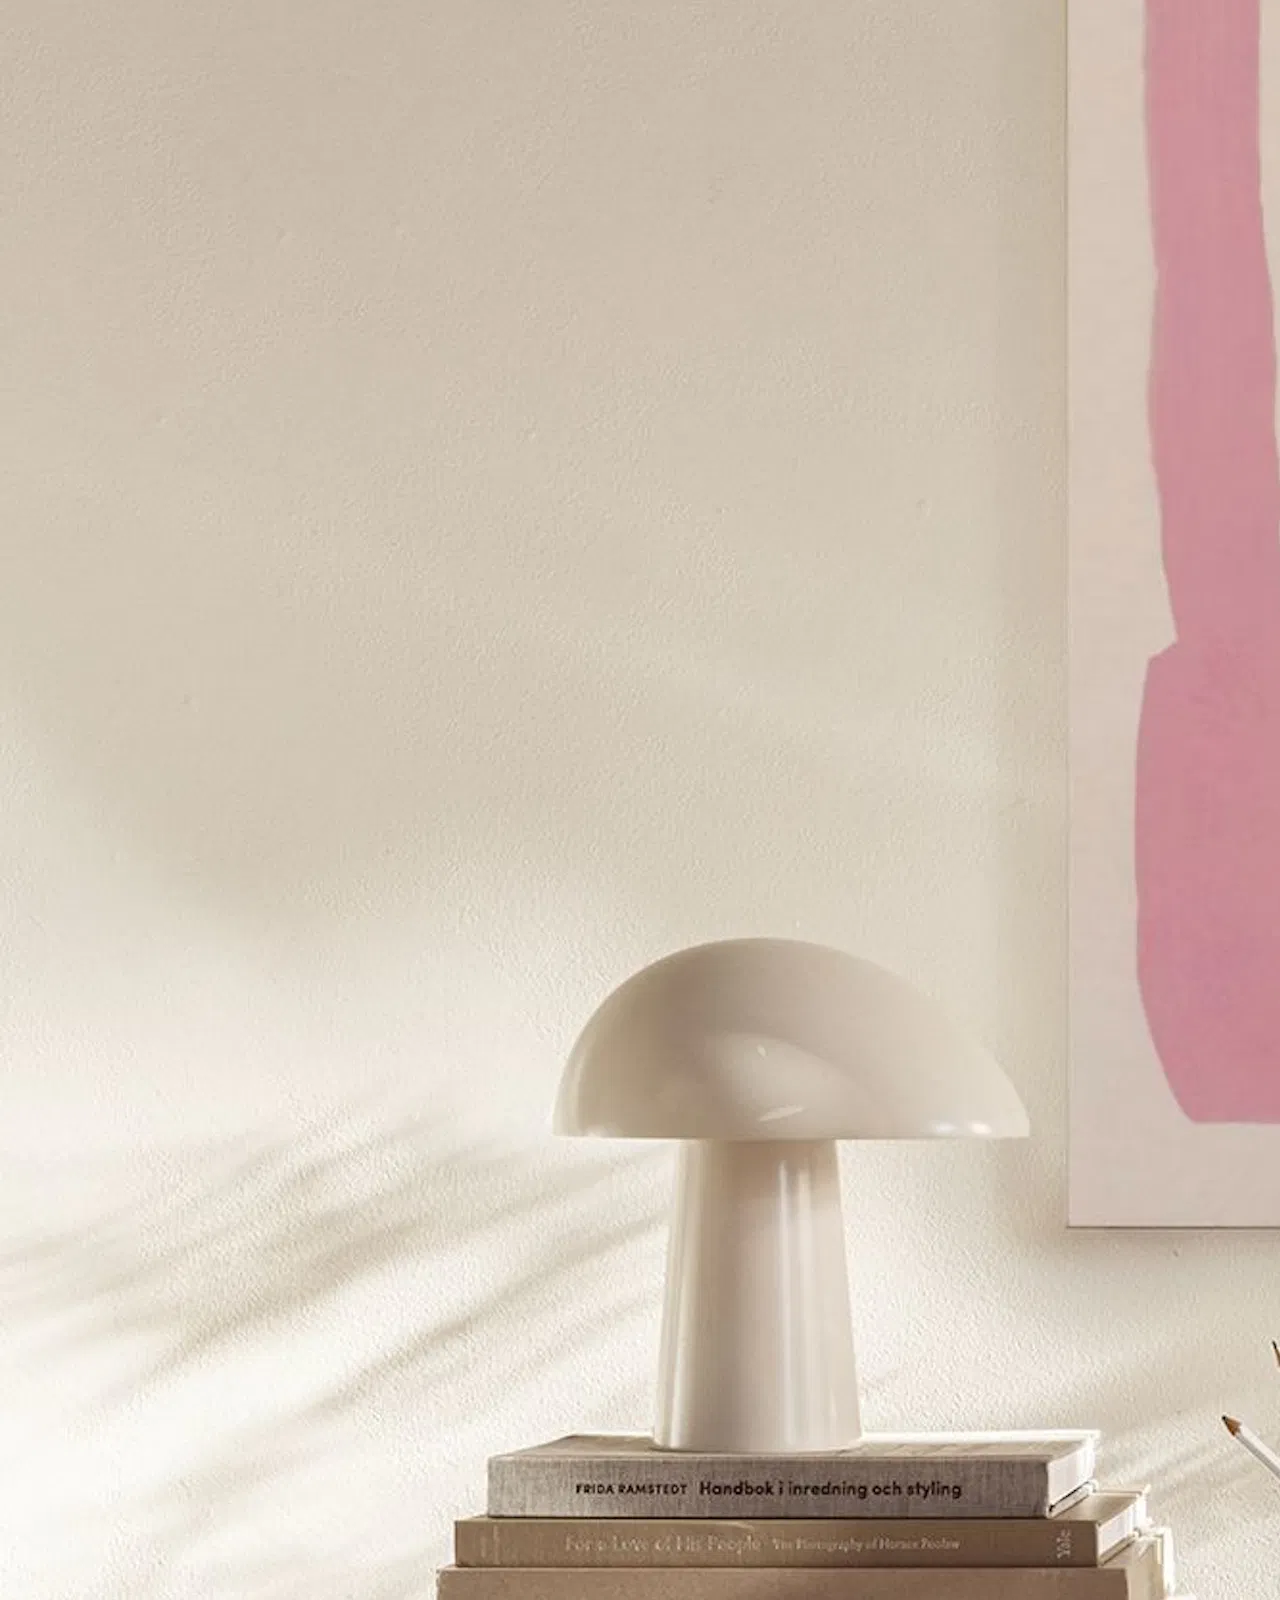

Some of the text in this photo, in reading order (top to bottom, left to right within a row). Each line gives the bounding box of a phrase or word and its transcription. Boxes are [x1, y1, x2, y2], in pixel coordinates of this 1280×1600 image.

[575, 1481, 962, 1499] FRIDA RAMSTEDT Handbok i inredning och styling
[706, 1535, 762, 1556] People
